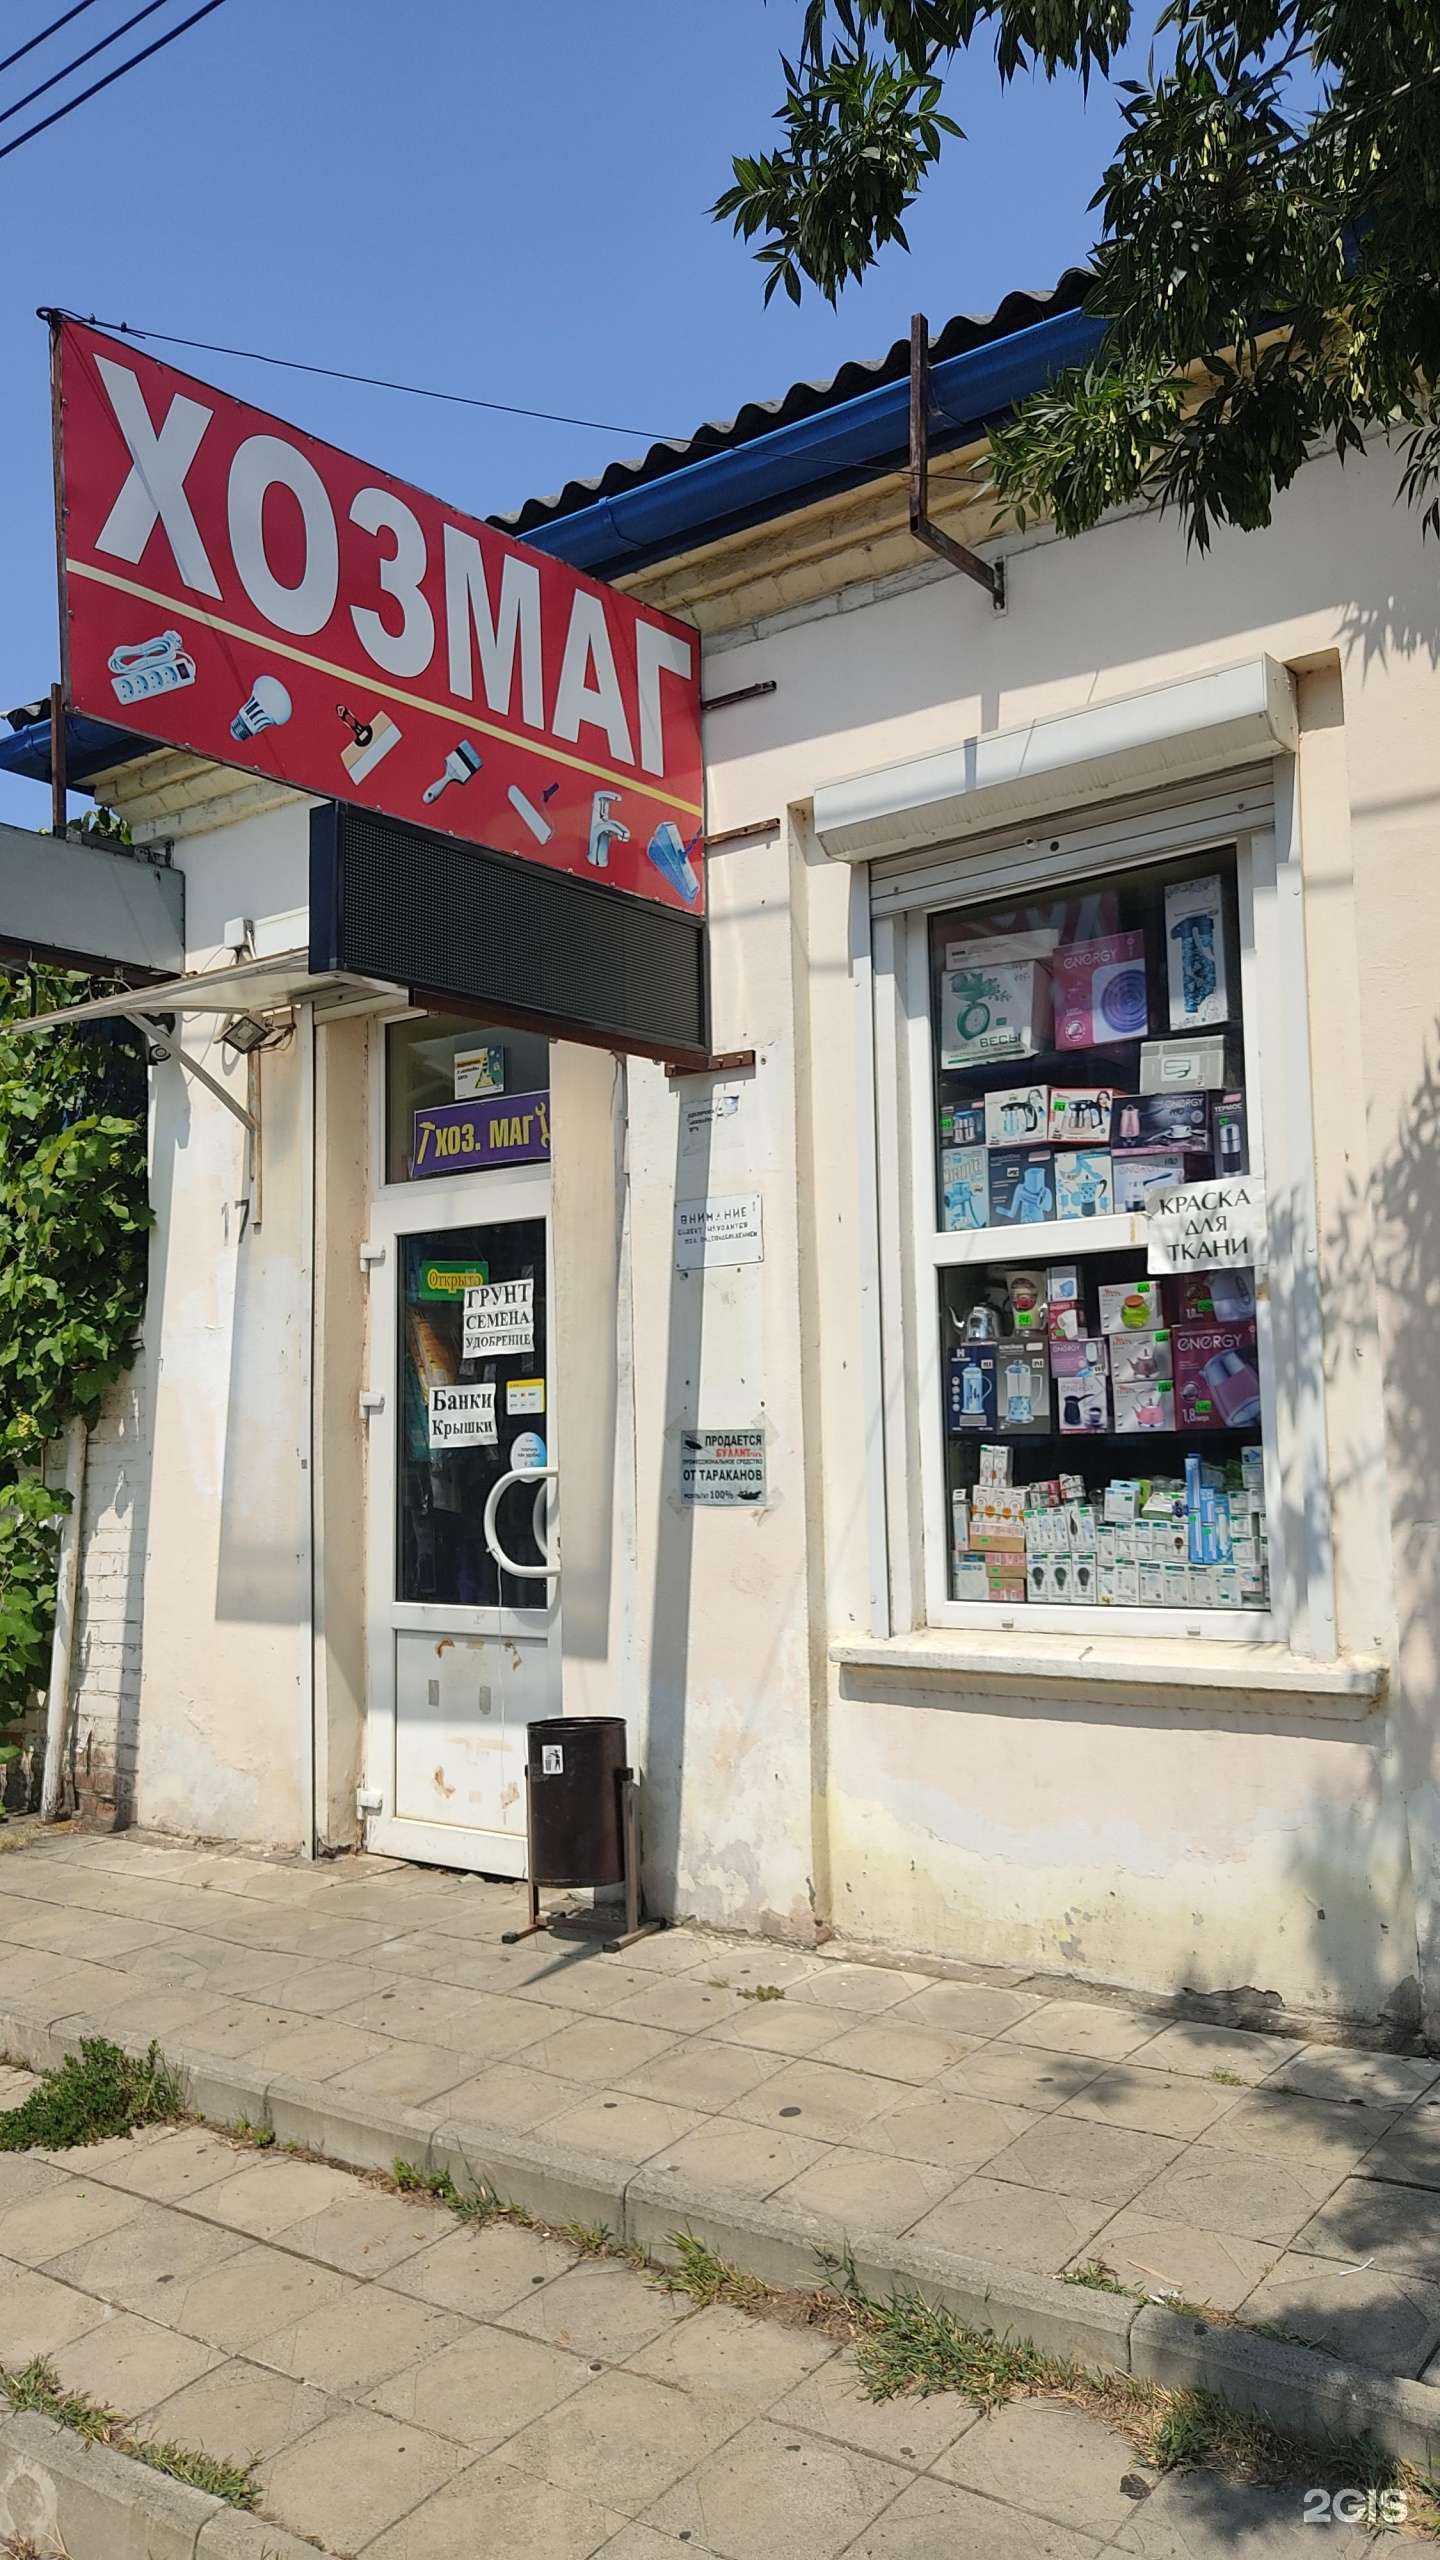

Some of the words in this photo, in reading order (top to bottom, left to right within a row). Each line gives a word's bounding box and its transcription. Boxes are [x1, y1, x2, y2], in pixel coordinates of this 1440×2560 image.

[93, 353, 691, 778] ХОЗМАГ
[980, 1033, 1021, 1048] ВЕСЫ
[1213, 1102, 1243, 1113] ТЕРМОС
[435, 1123, 481, 1157] ХОЗ.
[489, 1115, 534, 1149] МАГ
[1160, 1188, 1251, 1215] КРАСКА
[1185, 1215, 1228, 1236] ДЛЯ
[1166, 1236, 1249, 1261] ТКАНИ
[428, 1270, 483, 1292] Открыто
[466, 1283, 531, 1309] ГРУНТ
[466, 1310, 530, 1330] СЕМЕНА
[466, 1334, 531, 1350] УДОБРЕНИЕ
[1177, 1333, 1242, 1352] ENERGY
[431, 1389, 492, 1412] Банки
[431, 1419, 493, 1439] Крышки
[705, 1434, 762, 1449] ПРОДАЕТСЯ
[683, 1470, 696, 1481] ОТ
[700, 1470, 762, 1481] ТАРАКАНОВ
[710, 1490, 734, 1499] 100%
